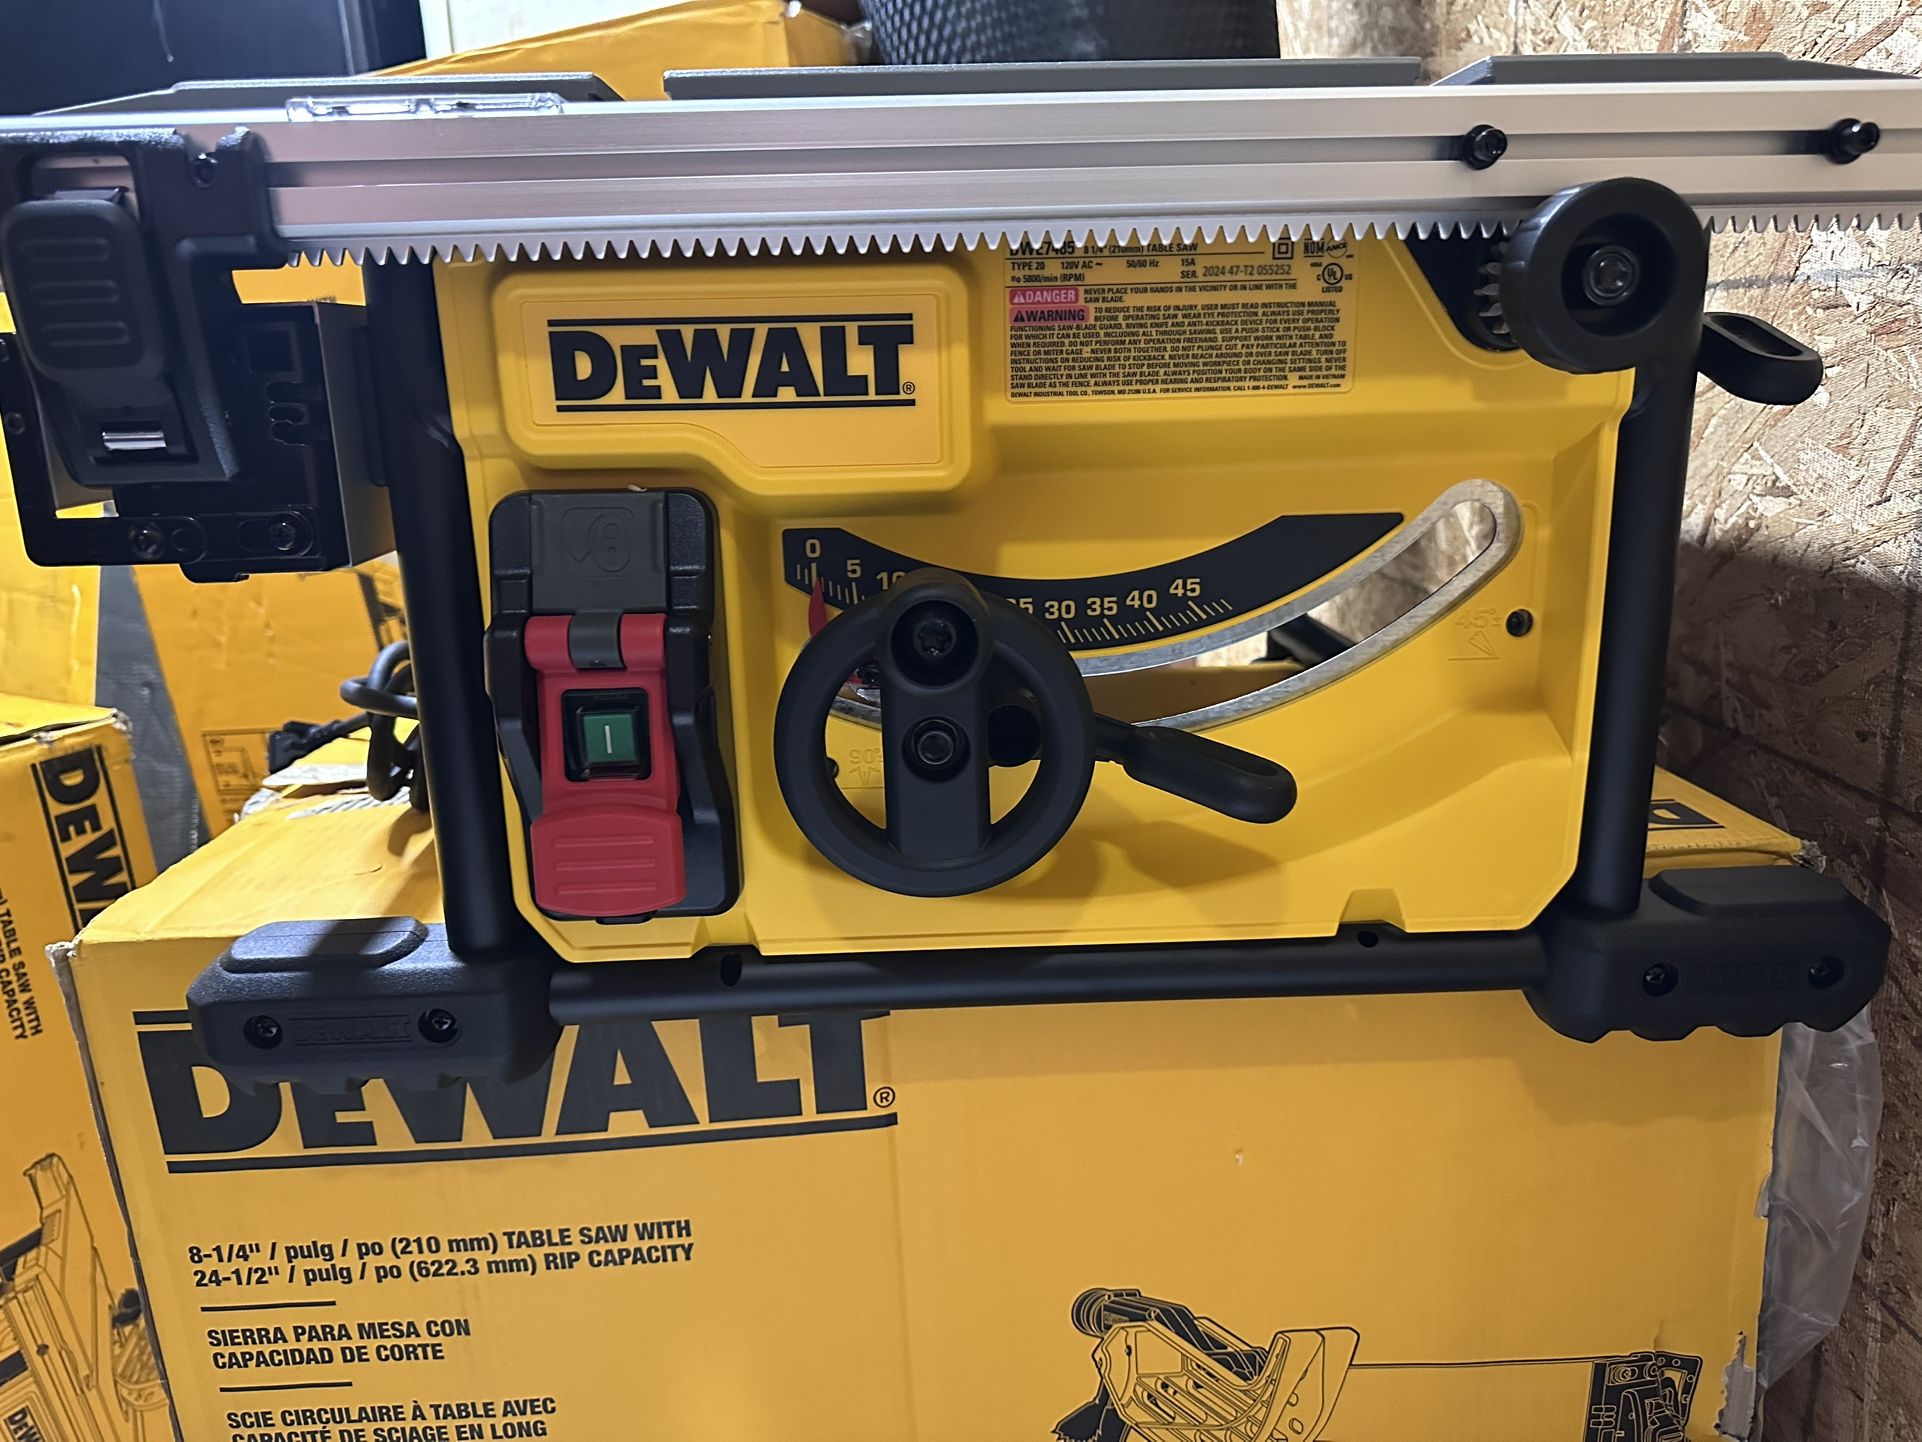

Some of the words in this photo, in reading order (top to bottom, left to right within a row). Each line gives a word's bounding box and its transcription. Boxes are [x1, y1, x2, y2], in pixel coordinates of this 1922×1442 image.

[1147, 244, 1173, 253] TABLE
[1176, 243, 1198, 252] SAW
[1304, 241, 1325, 254] NOM
[1010, 262, 1032, 270] TYPE
[1035, 262, 1044, 270] 20
[1060, 260, 1080, 269] 120V
[1081, 260, 1092, 268] AC
[1126, 259, 1147, 267] 50/60
[1148, 258, 1160, 267] Hz
[1180, 258, 1195, 266] 15A
[1060, 273, 1084, 282] (RPM)
[1180, 270, 1197, 278] SER.
[1202, 265, 1225, 276] 2024
[1227, 265, 1254, 276] 47-T2
[1256, 264, 1291, 275] 055252
[1025, 291, 1075, 303] DANGER
[1132, 305, 1144, 313] THE
[1200, 303, 1218, 311] USER
[1241, 302, 1259, 310] READ
[1260, 301, 1305, 309] INSTRUCTION
[1307, 300, 1336, 308] MANUAL
[1025, 309, 1084, 322] WARNING
[1094, 314, 1119, 322] BEFORE
[1122, 313, 1160, 321] OPERATING
[1202, 311, 1215, 319] EYE
[1261, 309, 1290, 317] ALWAYS
[1306, 308, 1340, 316] PROPERLY
[1010, 324, 1055, 332] FUNCTIONING
[1125, 321, 1148, 329] RIVING
[1170, 320, 1185, 328] AND
[1240, 318, 1263, 326] DEVICE
[1279, 317, 1300, 325] EVERY
[1301, 316, 1340, 324] OPERATION
[1024, 332, 1047, 340] WHICH
[1103, 330, 1140, 338] INCLUDING
[1141, 329, 1153, 337] ALL
[1094, 338, 1126, 346] PERFORM
[1318, 332, 1333, 340] AND
[805, 539, 821, 558] 0
[847, 560, 861, 578] 5
[1045, 601, 1076, 619] 30
[1087, 597, 1118, 615] 35
[1126, 590, 1157, 609] 40
[1169, 578, 1201, 597] 45
[0, 908, 22, 960] TABLE
[12, 961, 32, 994] SAW
[23, 996, 43, 1036] WITH
[0, 968, 28, 1041] CAPACITY
[188, 1242, 261, 1264] 8-1/4"
[269, 1242, 277, 1260] /
[284, 1240, 334, 1264] pulg
[341, 1238, 349, 1257] /
[356, 1241, 384, 1262] po
[391, 1236, 441, 1260] (210
[447, 1232, 499, 1255] mm)
[502, 1227, 573, 1249] TABLE
[579, 1224, 628, 1245] SAW
[634, 1219, 692, 1241] WITH
[193, 1266, 280, 1287] 24-1/2"
[288, 1265, 295, 1284] /
[303, 1263, 353, 1287] pulg
[359, 1262, 367, 1280] /
[375, 1264, 402, 1283] po
[409, 1258, 480, 1282] (622.3
[487, 1254, 537, 1276] mm)
[544, 1251, 581, 1271] RIP
[588, 1243, 694, 1268] CAPACITY
[207, 1327, 288, 1347] SIERRA
[293, 1324, 352, 1343] PARA
[357, 1321, 421, 1340] MESA
[426, 1318, 471, 1338] CON
[213, 1347, 334, 1370] CAPACIDAD
[340, 1346, 370, 1363] DE
[376, 1343, 445, 1362] CORTE
[226, 1410, 275, 1429] SCIE
[281, 1405, 406, 1427] CIRCULAIRE
[411, 1400, 426, 1421] À
[429, 1401, 496, 1420] TABLE
[502, 1397, 557, 1418] AVEC
[340, 1429, 367, 1442] DE
[372, 1426, 449, 1442] SCIAGE
[455, 1424, 484, 1442] EN
[491, 1420, 548, 1440] LONG
